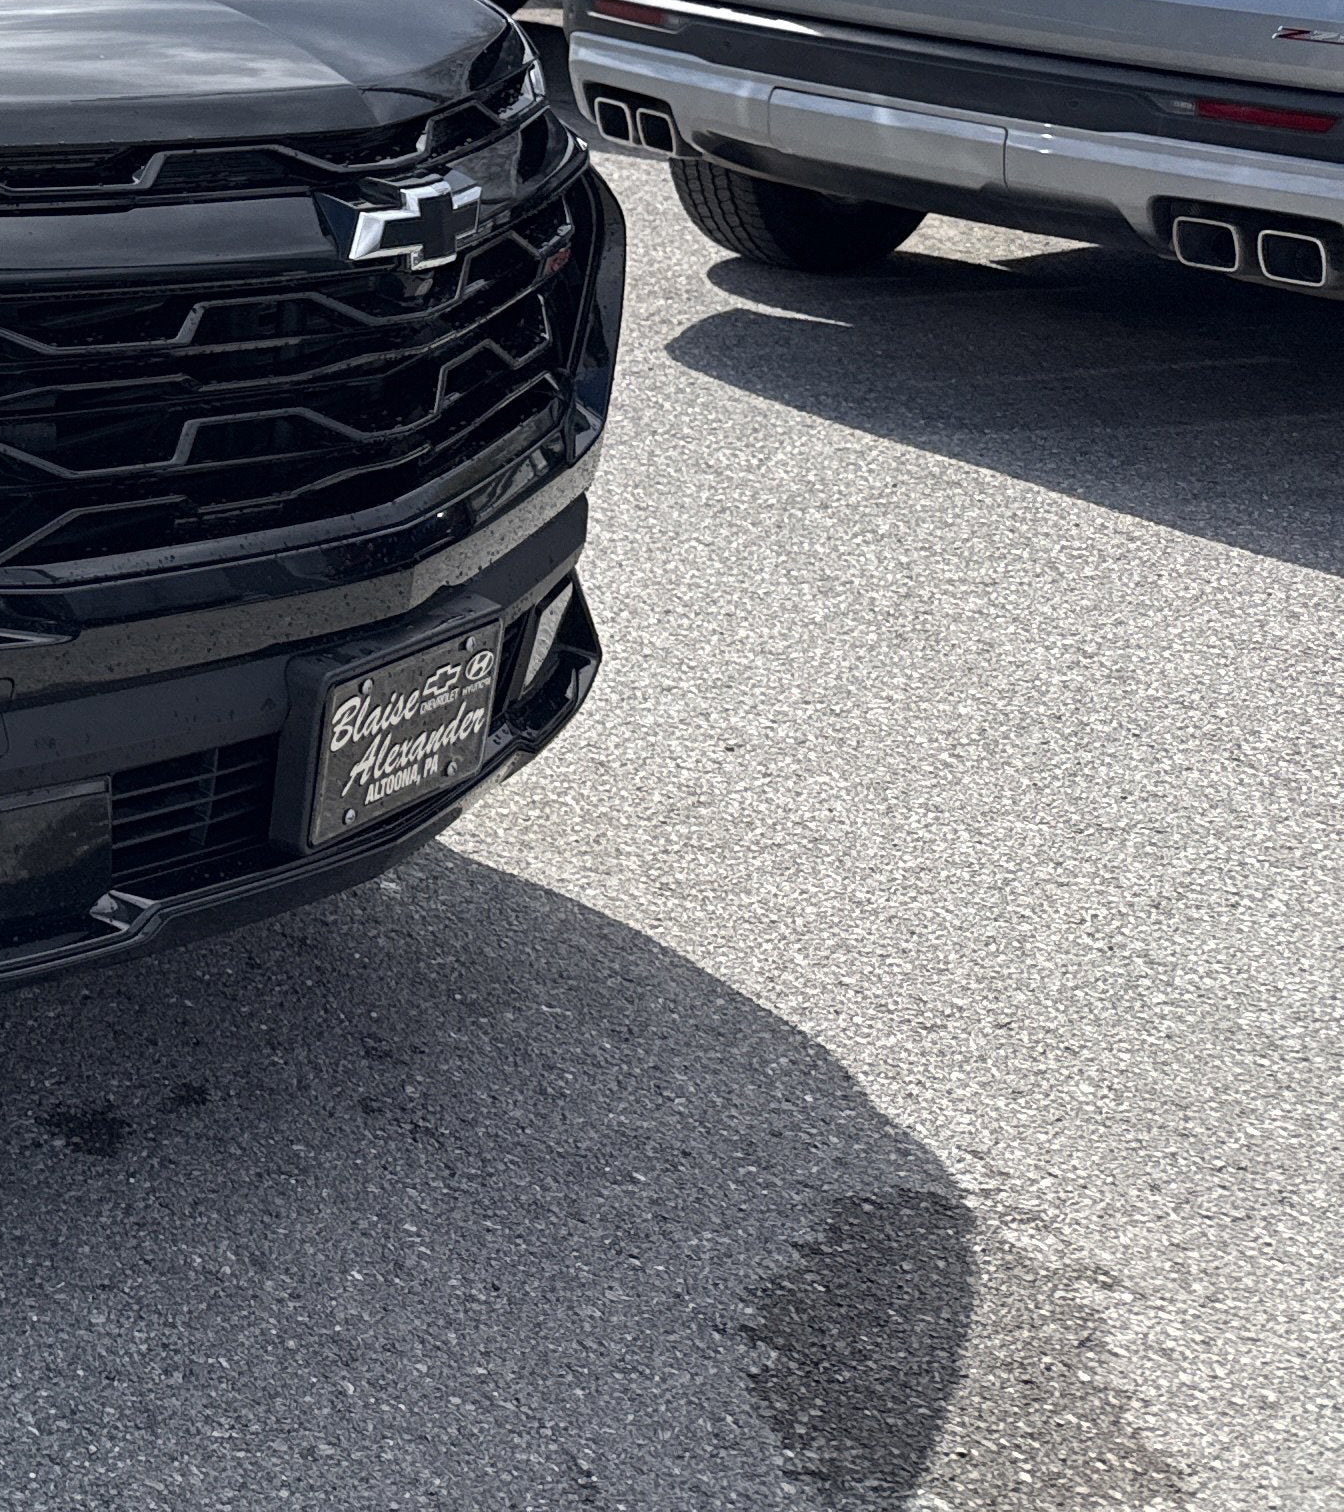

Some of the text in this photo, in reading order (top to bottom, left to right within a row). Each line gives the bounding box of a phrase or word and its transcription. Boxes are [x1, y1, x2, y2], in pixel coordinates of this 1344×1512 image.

[330, 689, 421, 752] Blaise
[341, 701, 486, 797] Alexander
[423, 754, 439, 778] PA
